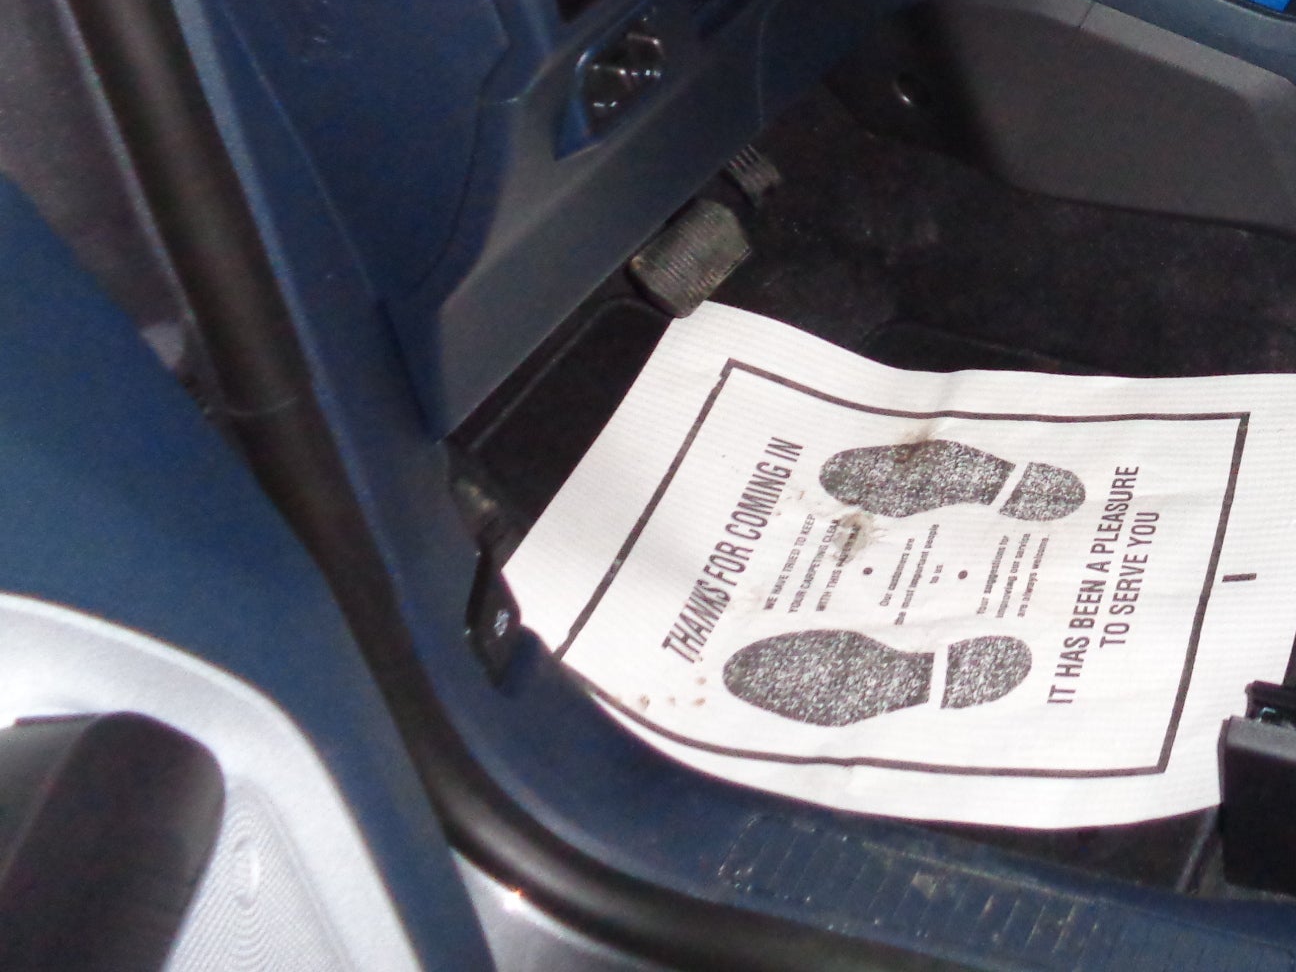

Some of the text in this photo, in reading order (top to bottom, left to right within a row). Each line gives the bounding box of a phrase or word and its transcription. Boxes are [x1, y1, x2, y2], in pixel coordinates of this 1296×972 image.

[661, 436, 803, 663] THANKS FOR COMING IN
[763, 514, 815, 610] WE HAVE TRIED TO KEEP
[787, 519, 841, 613] YOUR CARPETING CLEAN
[816, 591, 832, 611] WITH
[825, 569, 841, 588] THIS
[879, 538, 915, 606] Our customers are
[894, 524, 940, 625] the most important people
[929, 564, 943, 584] to us
[976, 535, 1009, 614] Your suggestions for
[995, 533, 1031, 618] improving our service
[1022, 572, 1038, 601] always
[1047, 466, 1139, 704] IT HAS BEEN A PLEASURE
[1099, 512, 1160, 648] TO SERVE YOU
[1017, 604, 1028, 617] are
